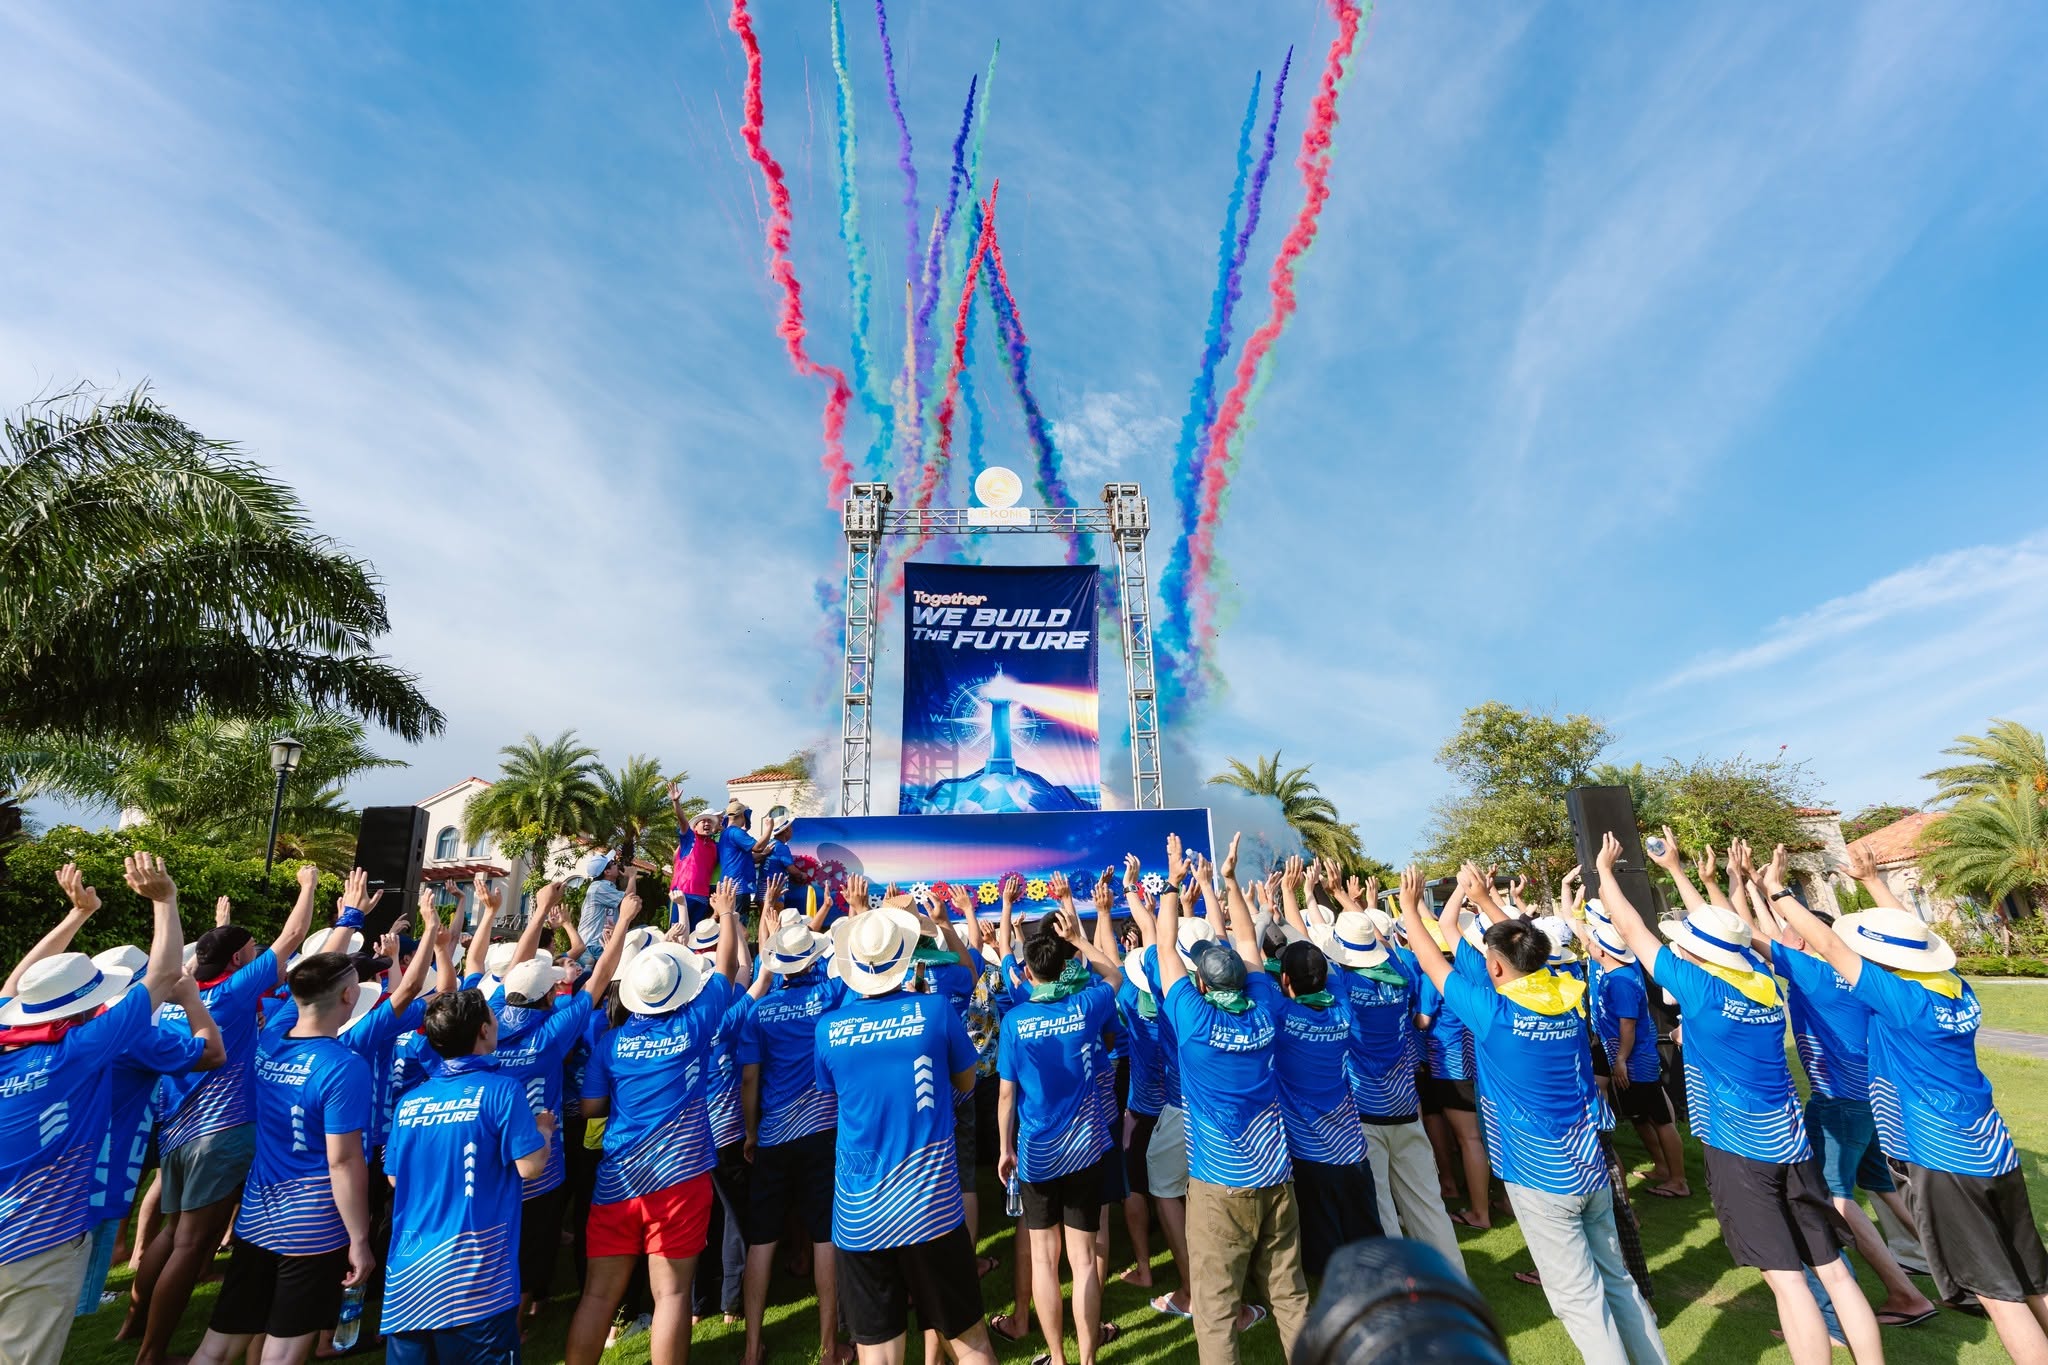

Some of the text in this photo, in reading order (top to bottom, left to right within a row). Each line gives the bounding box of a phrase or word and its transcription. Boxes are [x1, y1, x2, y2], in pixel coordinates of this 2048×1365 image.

[913, 590, 987, 607] Together
[913, 605, 1072, 627] WE BUILD
[913, 627, 1090, 650] THE FUTURE
[930, 713, 943, 723] W
[758, 1007, 776, 1017] WE
[774, 1006, 822, 1023] FUTURE
[829, 1015, 915, 1040] WE BUILD
[830, 1016, 868, 1028] Together
[1017, 1016, 1044, 1025] Together
[1018, 1014, 1079, 1034] WE BUILD
[1285, 1019, 1308, 1031] WE
[1514, 1019, 1536, 1030] WE
[830, 1024, 925, 1048] THE FUTURE
[1019, 1021, 1086, 1040] THE FUTURE
[1211, 1031, 1232, 1042] WE
[1284, 1026, 1349, 1042] THE FUTURE
[1512, 1027, 1578, 1041] THE FUTURE
[617, 1041, 643, 1052] WE
[617, 1039, 692, 1060] THE FUTURE
[1209, 1040, 1226, 1049] THE
[491, 1049, 530, 1058] UILD
[499, 1055, 536, 1067] TURE
[257, 1069, 307, 1086] FUTURE
[398, 1099, 473, 1119] WE BUILD
[411, 1111, 479, 1128] FUTURE
